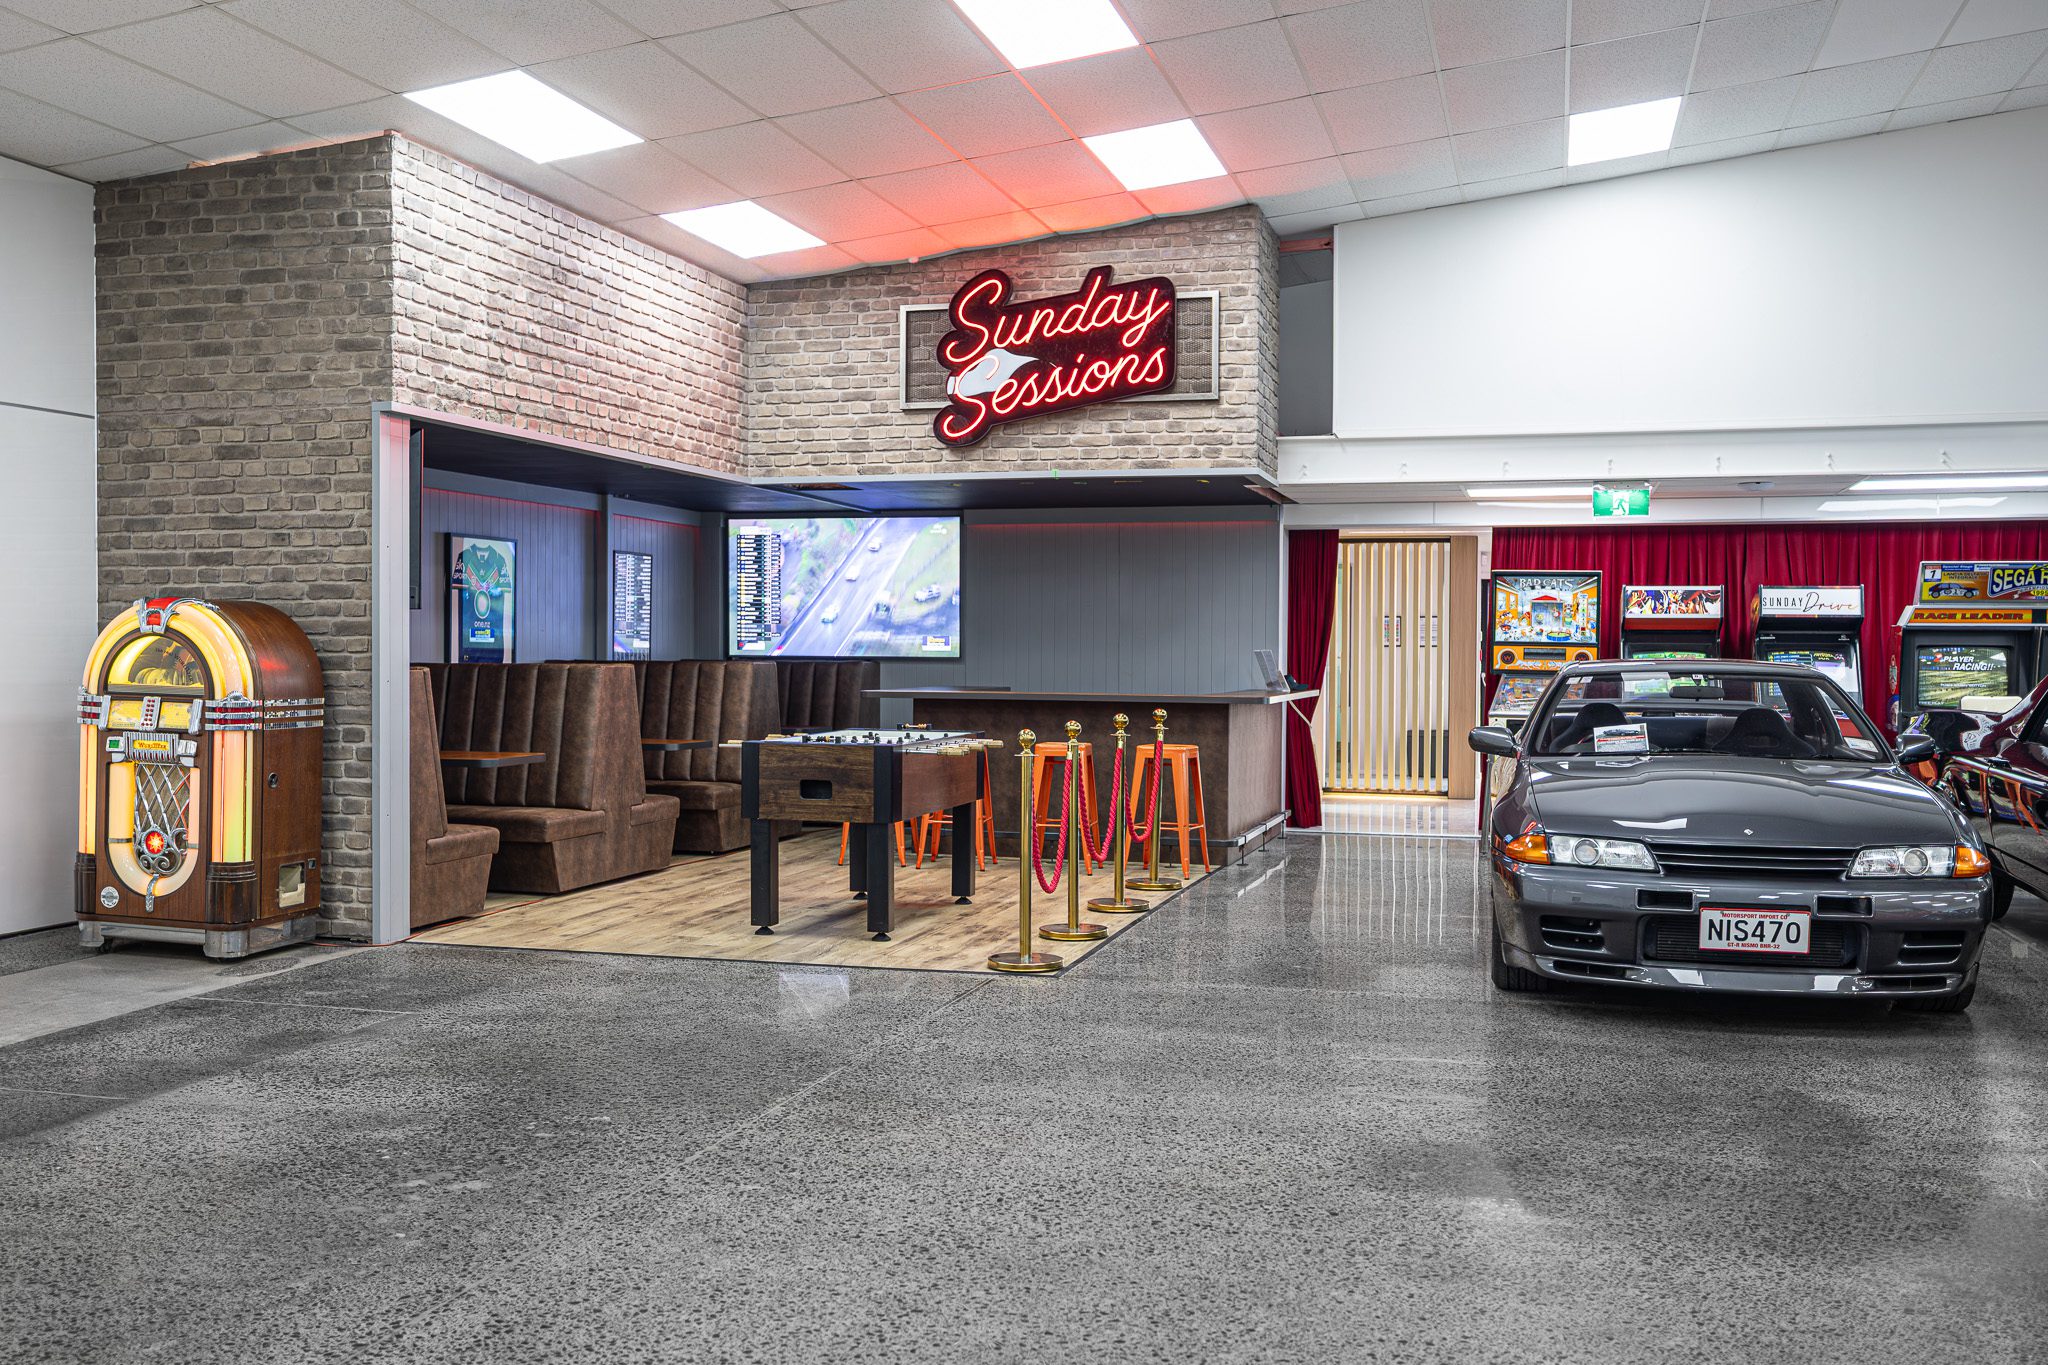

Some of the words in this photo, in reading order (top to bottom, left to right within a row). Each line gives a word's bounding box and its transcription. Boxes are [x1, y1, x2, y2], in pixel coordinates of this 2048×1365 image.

[943, 274, 1171, 364] Sunday
[941, 346, 1168, 439] Sessions
[1519, 578, 1541, 588] BAD
[1543, 578, 1574, 588] CATS
[1930, 569, 1937, 579] 1
[1992, 568, 2036, 593] SEGA
[1762, 597, 1803, 607] SUNDAY
[1802, 591, 1858, 613] Drive
[1913, 612, 1957, 620] RACE
[1960, 612, 2024, 620] LEADER
[1952, 662, 1994, 671] RACING!!
[1707, 918, 1801, 944] NIS470
